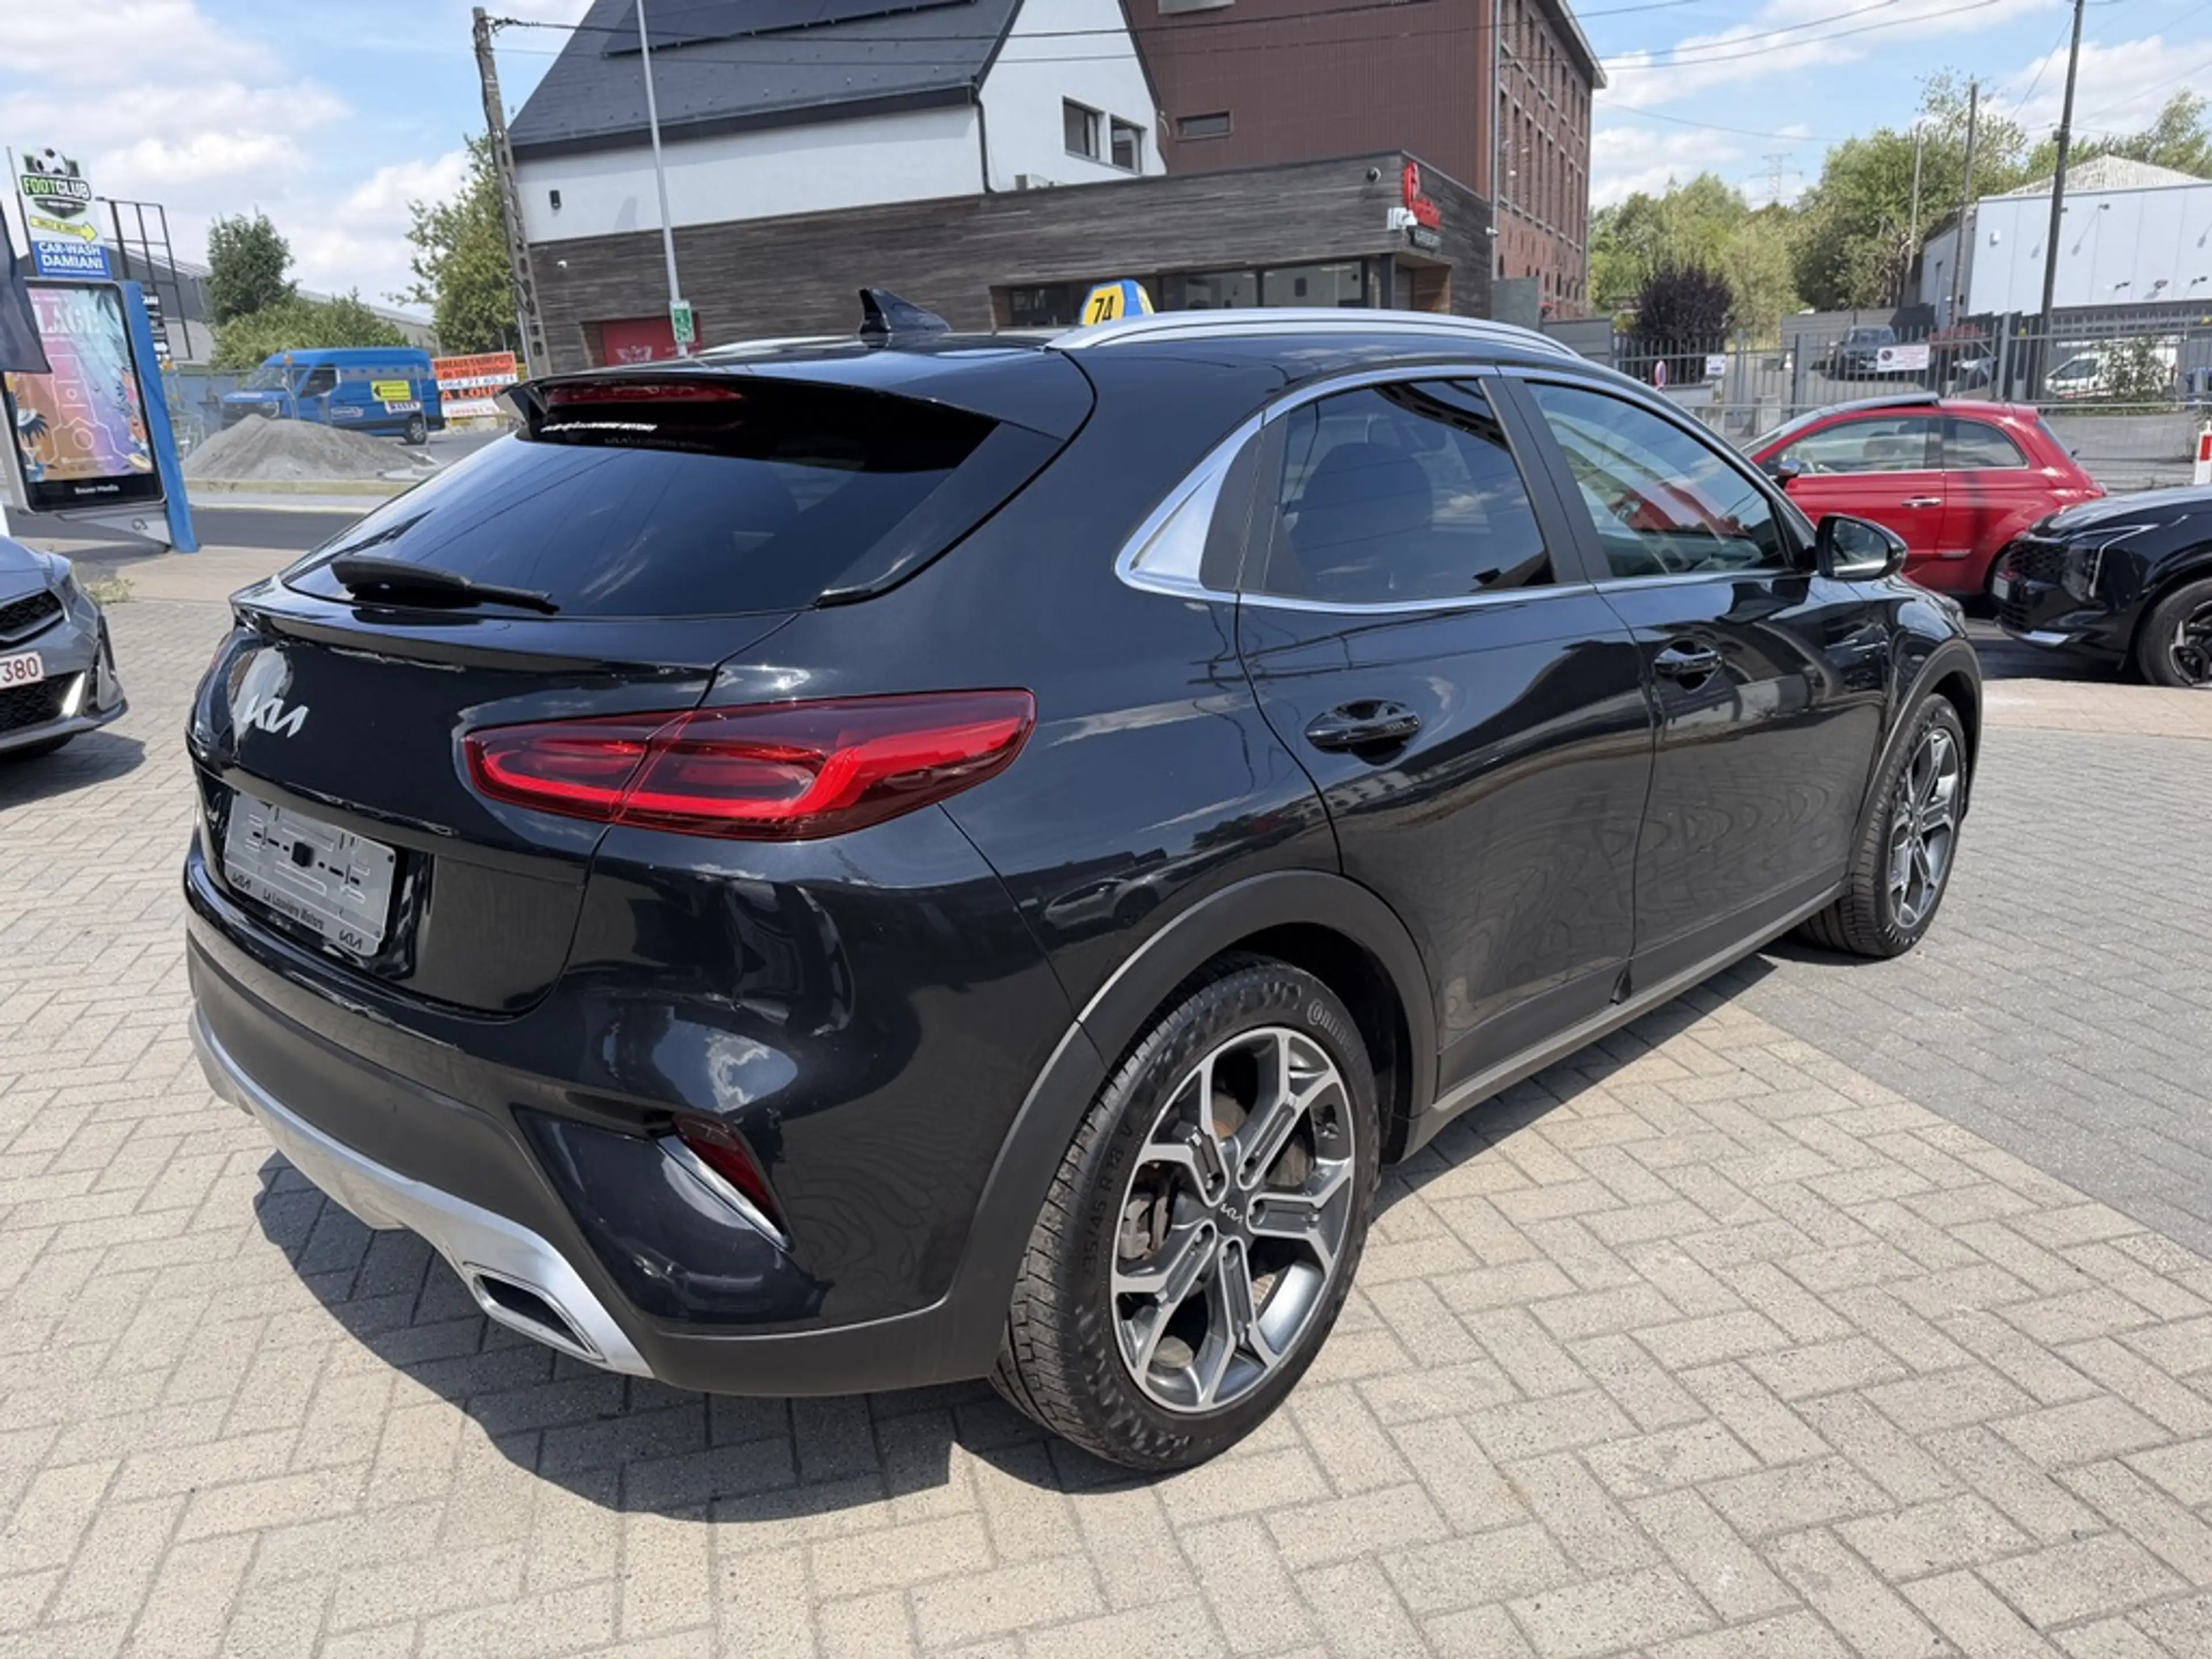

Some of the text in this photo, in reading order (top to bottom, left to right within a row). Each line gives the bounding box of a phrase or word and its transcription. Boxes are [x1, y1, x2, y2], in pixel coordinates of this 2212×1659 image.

[41, 255, 103, 268] DAMIANI
[1094, 296, 1114, 323] 74
[2, 657, 39, 682] 380
[241, 694, 310, 738] KIA
